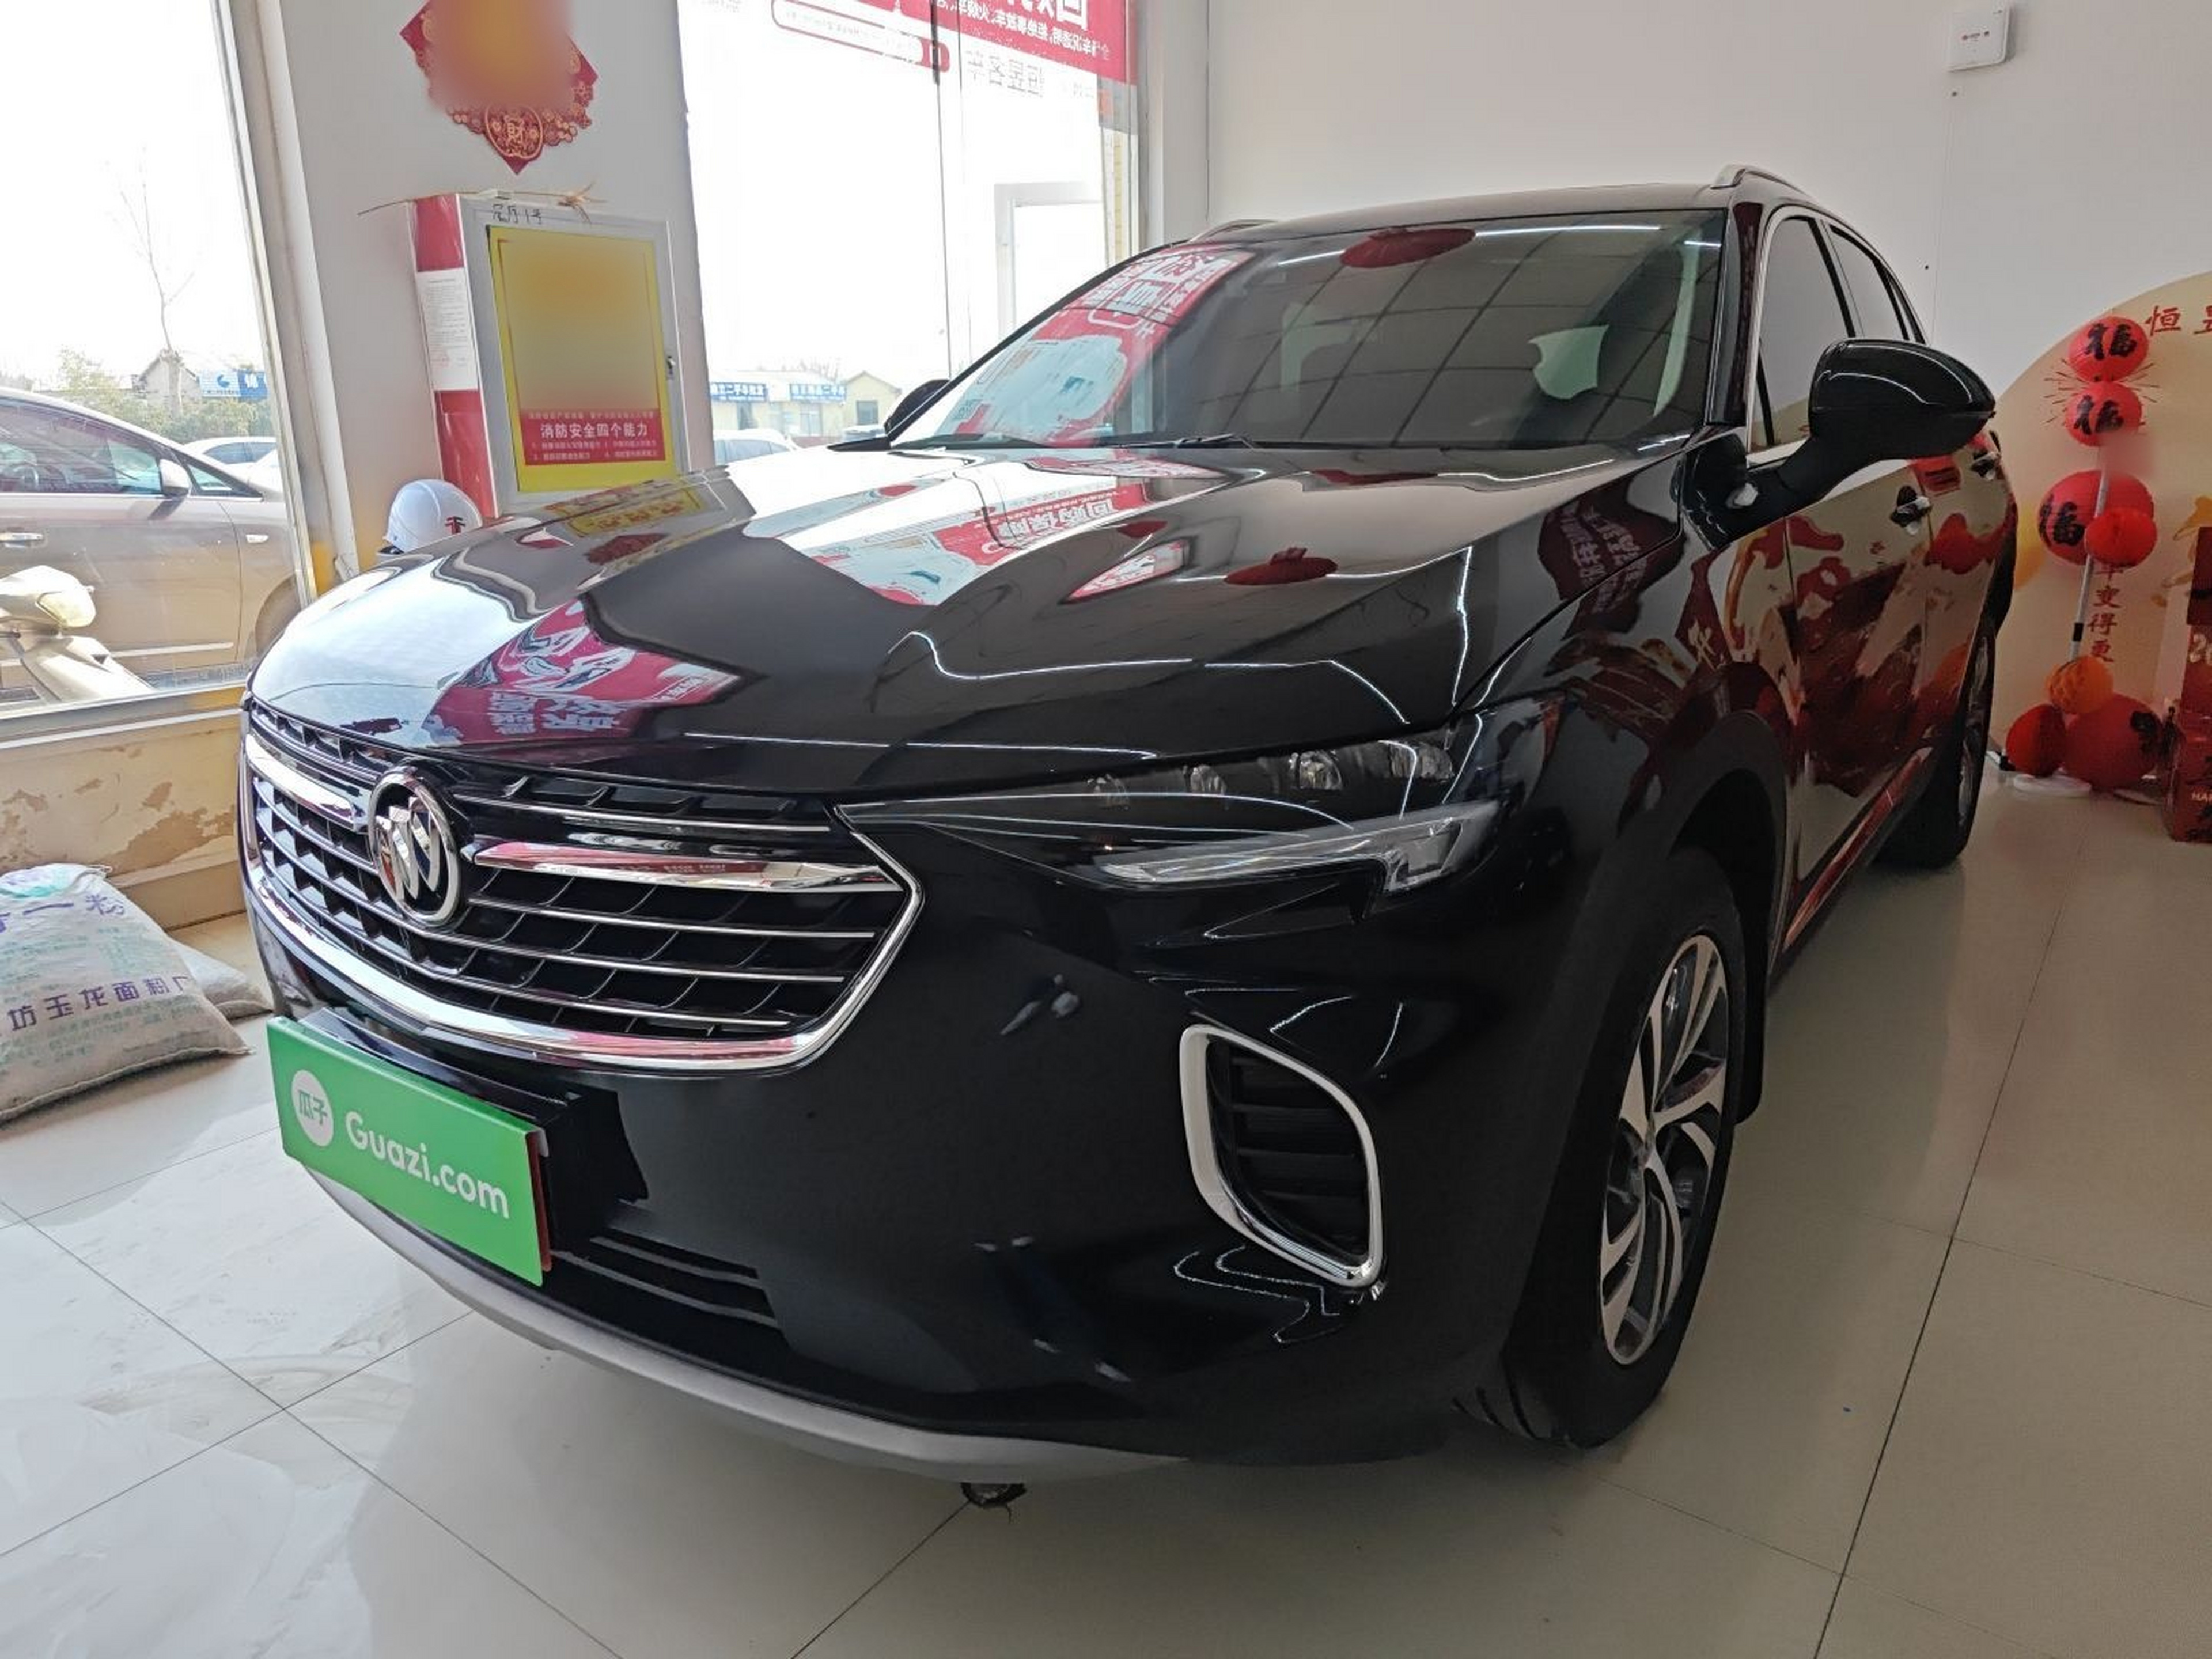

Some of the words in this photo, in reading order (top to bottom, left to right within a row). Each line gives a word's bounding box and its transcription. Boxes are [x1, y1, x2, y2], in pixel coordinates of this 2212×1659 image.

[2084, 323, 2138, 360] 福
[540, 421, 648, 439] 消防安全四个能力
[2074, 395, 2125, 435] 福
[7, 976, 188, 1031] 坊玉龙面粉厂
[298, 1088, 328, 1125] 瓜子
[346, 1111, 509, 1218] Guazi.com
